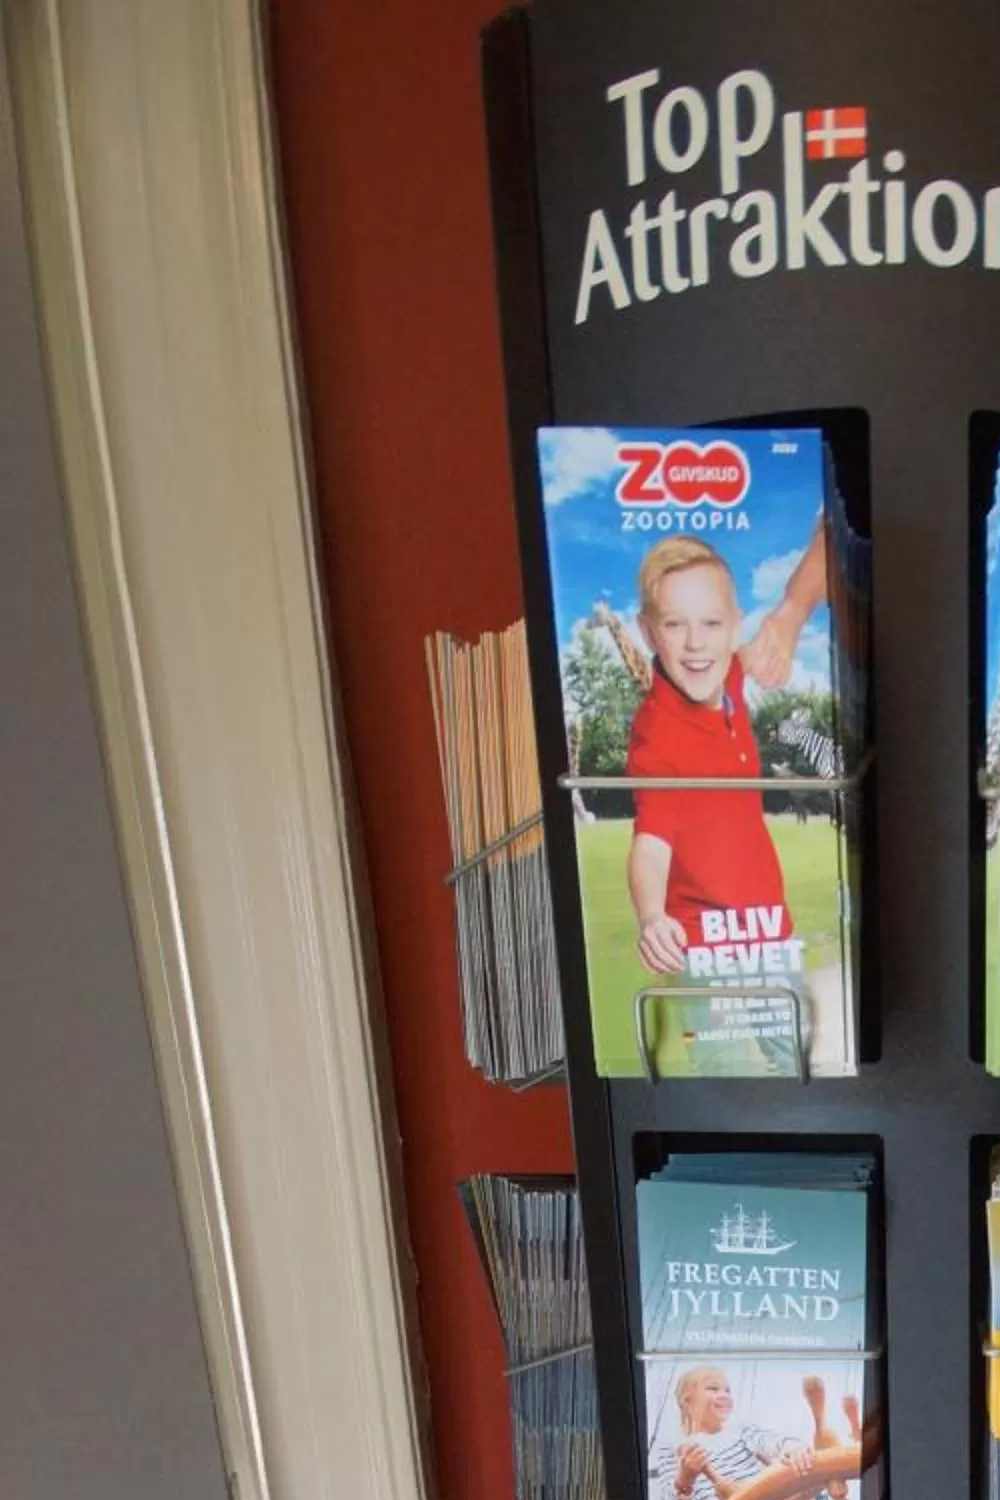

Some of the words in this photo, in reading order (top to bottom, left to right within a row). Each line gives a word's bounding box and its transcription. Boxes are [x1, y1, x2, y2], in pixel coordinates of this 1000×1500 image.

[607, 67, 774, 194] Top
[669, 465, 739, 482] GIVSKUD
[620, 510, 751, 531] ZOOTOPIA
[700, 905, 783, 943] BLIV
[688, 939, 805, 978] REVET
[666, 1261, 841, 1291] FREGATTEN
[667, 1287, 840, 1321] JYLLAND
